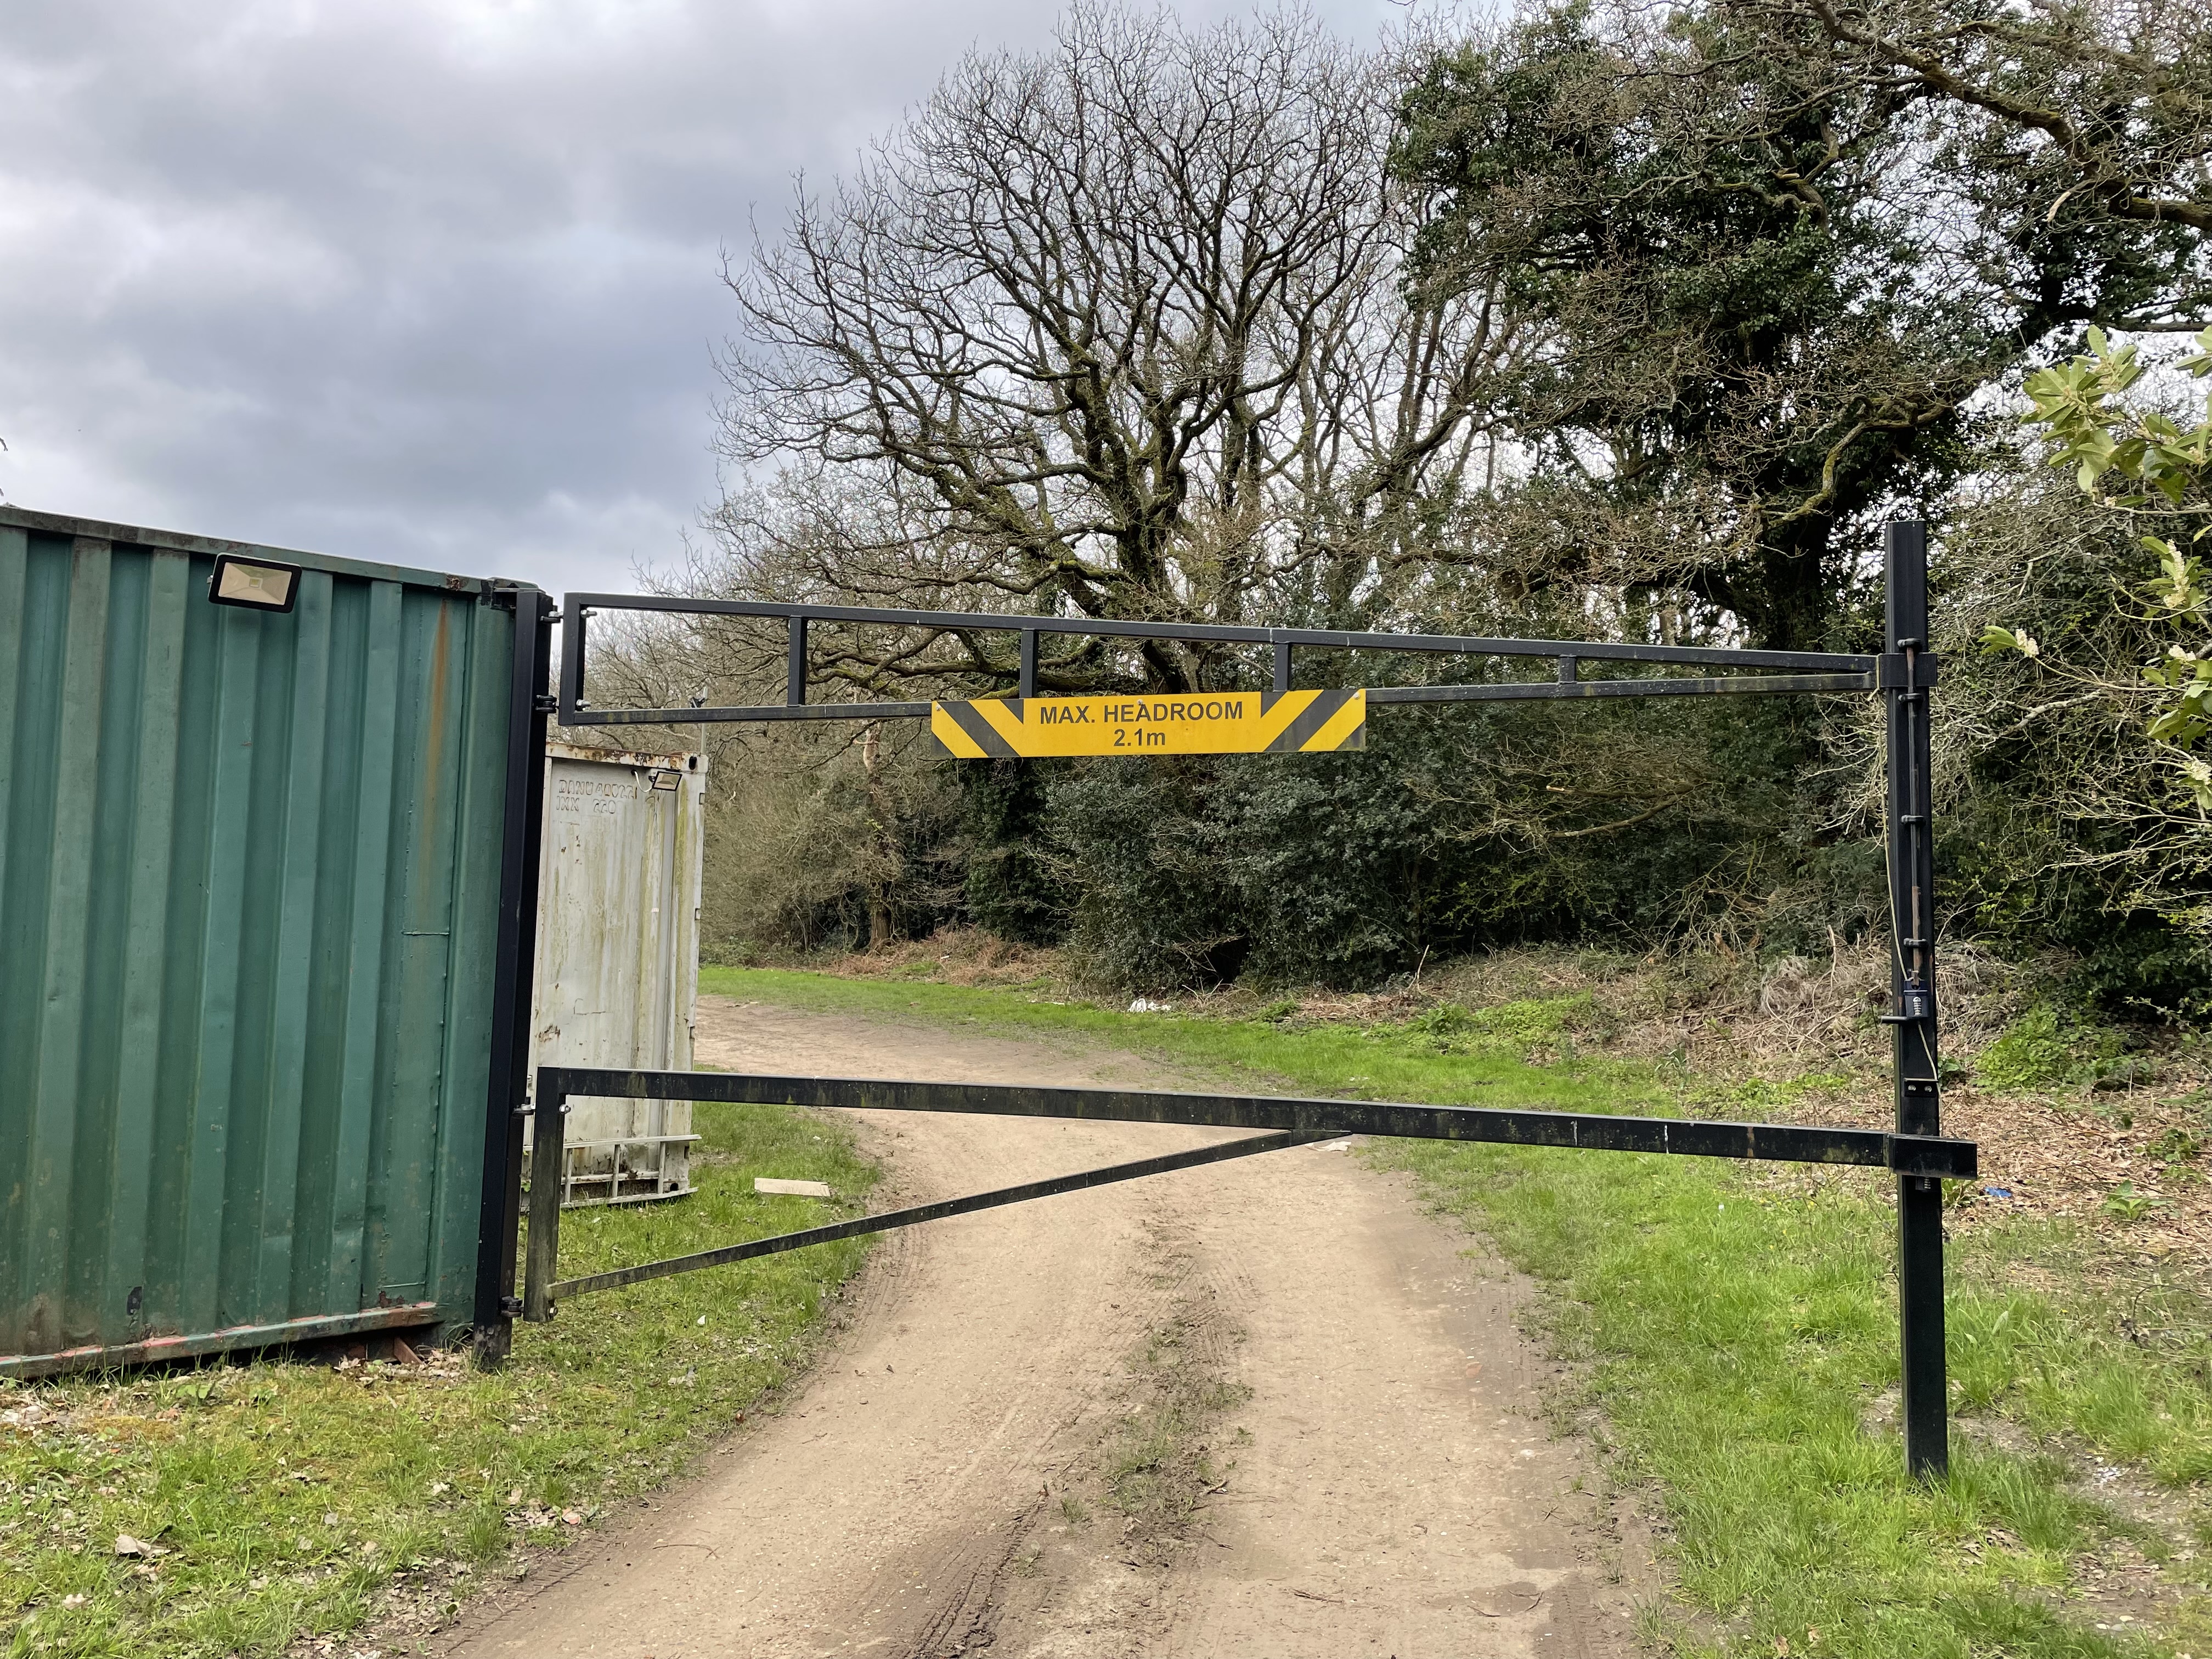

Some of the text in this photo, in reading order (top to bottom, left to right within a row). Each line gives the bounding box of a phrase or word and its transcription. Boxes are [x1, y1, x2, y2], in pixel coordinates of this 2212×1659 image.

[1041, 702, 1242, 724] MAX. HEADROOM
[1114, 729, 1165, 746] 2.1m
